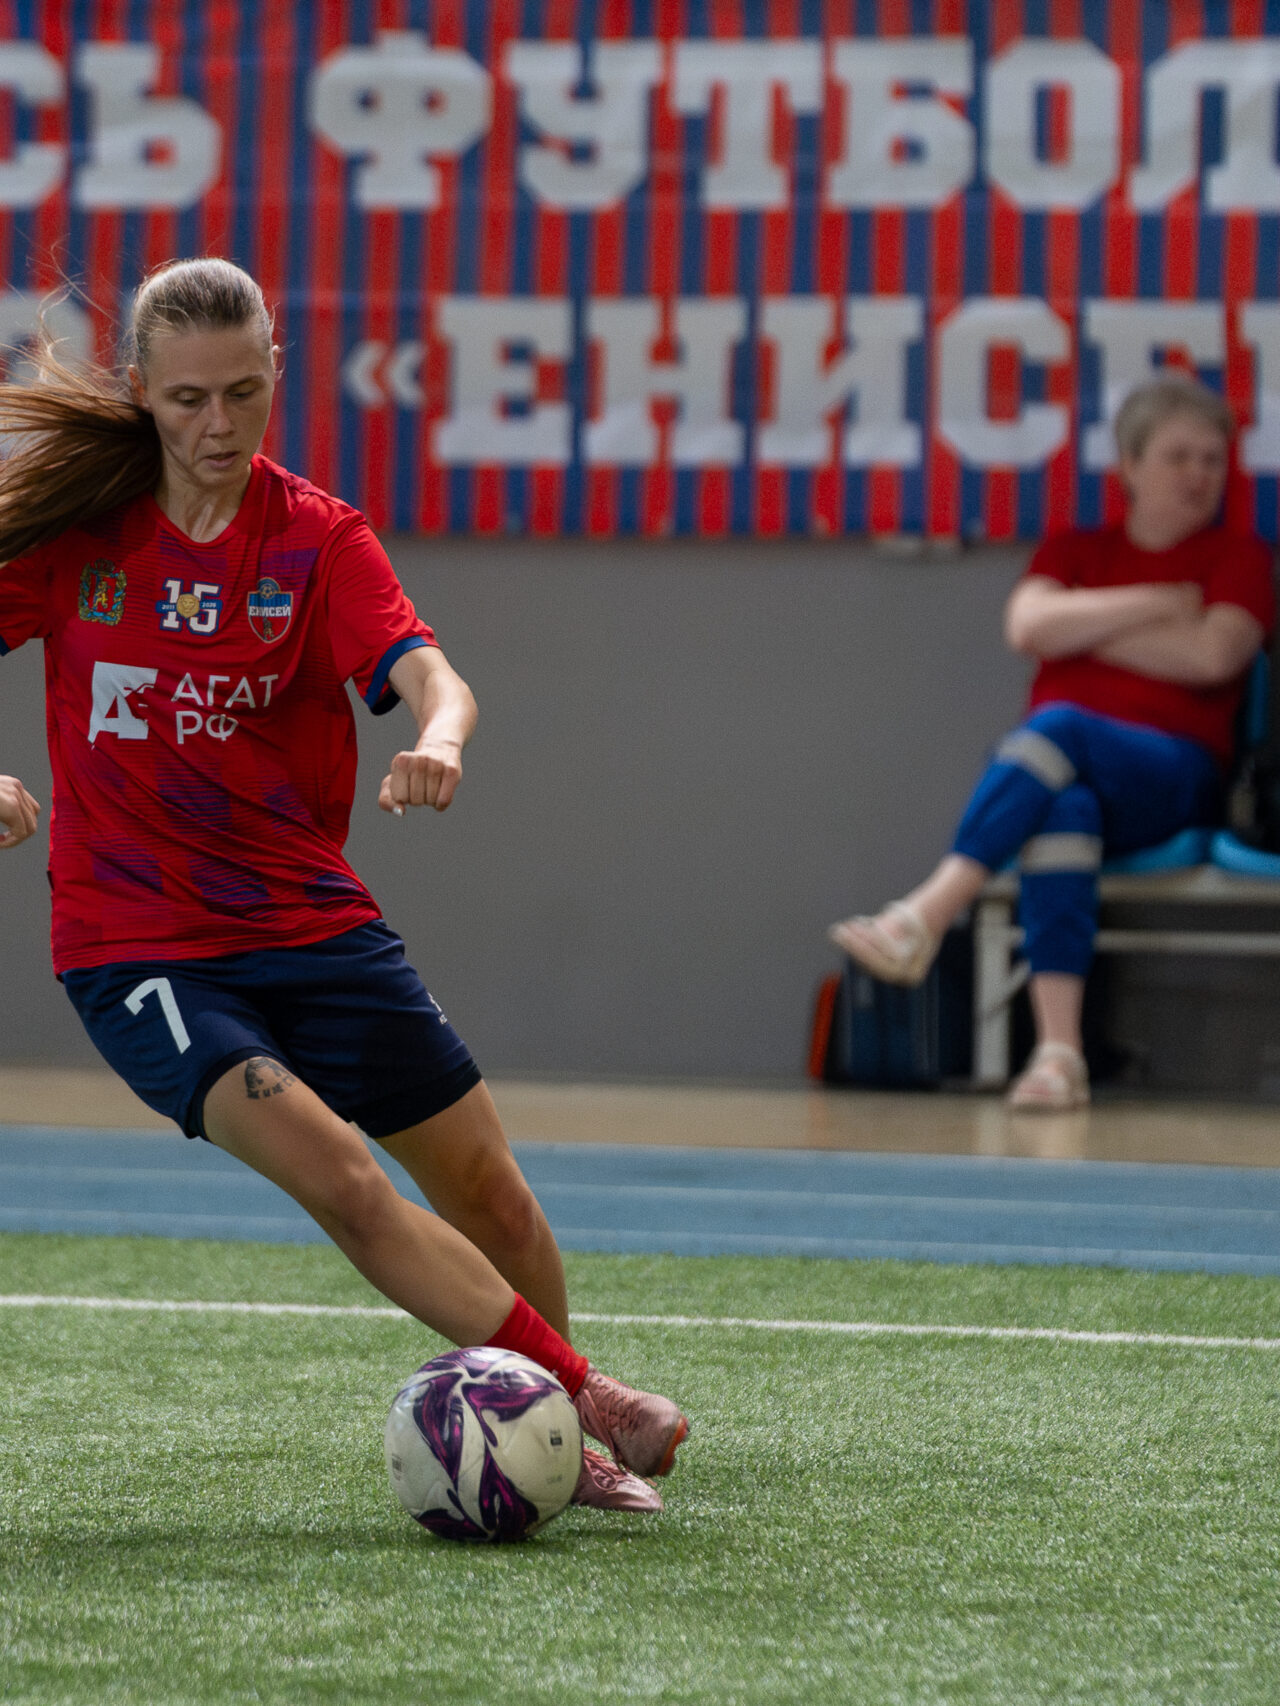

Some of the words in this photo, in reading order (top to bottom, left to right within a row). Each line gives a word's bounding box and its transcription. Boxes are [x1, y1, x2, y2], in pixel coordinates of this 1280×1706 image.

[342, 296, 1280, 474] «ЕНИСЕ
[162, 579, 219, 633] 15
[248, 604, 291, 617] ЕНИСЕЙ
[170, 672, 279, 709] АГАТ
[175, 710, 239, 745] РФ
[124, 976, 191, 1054] 7
